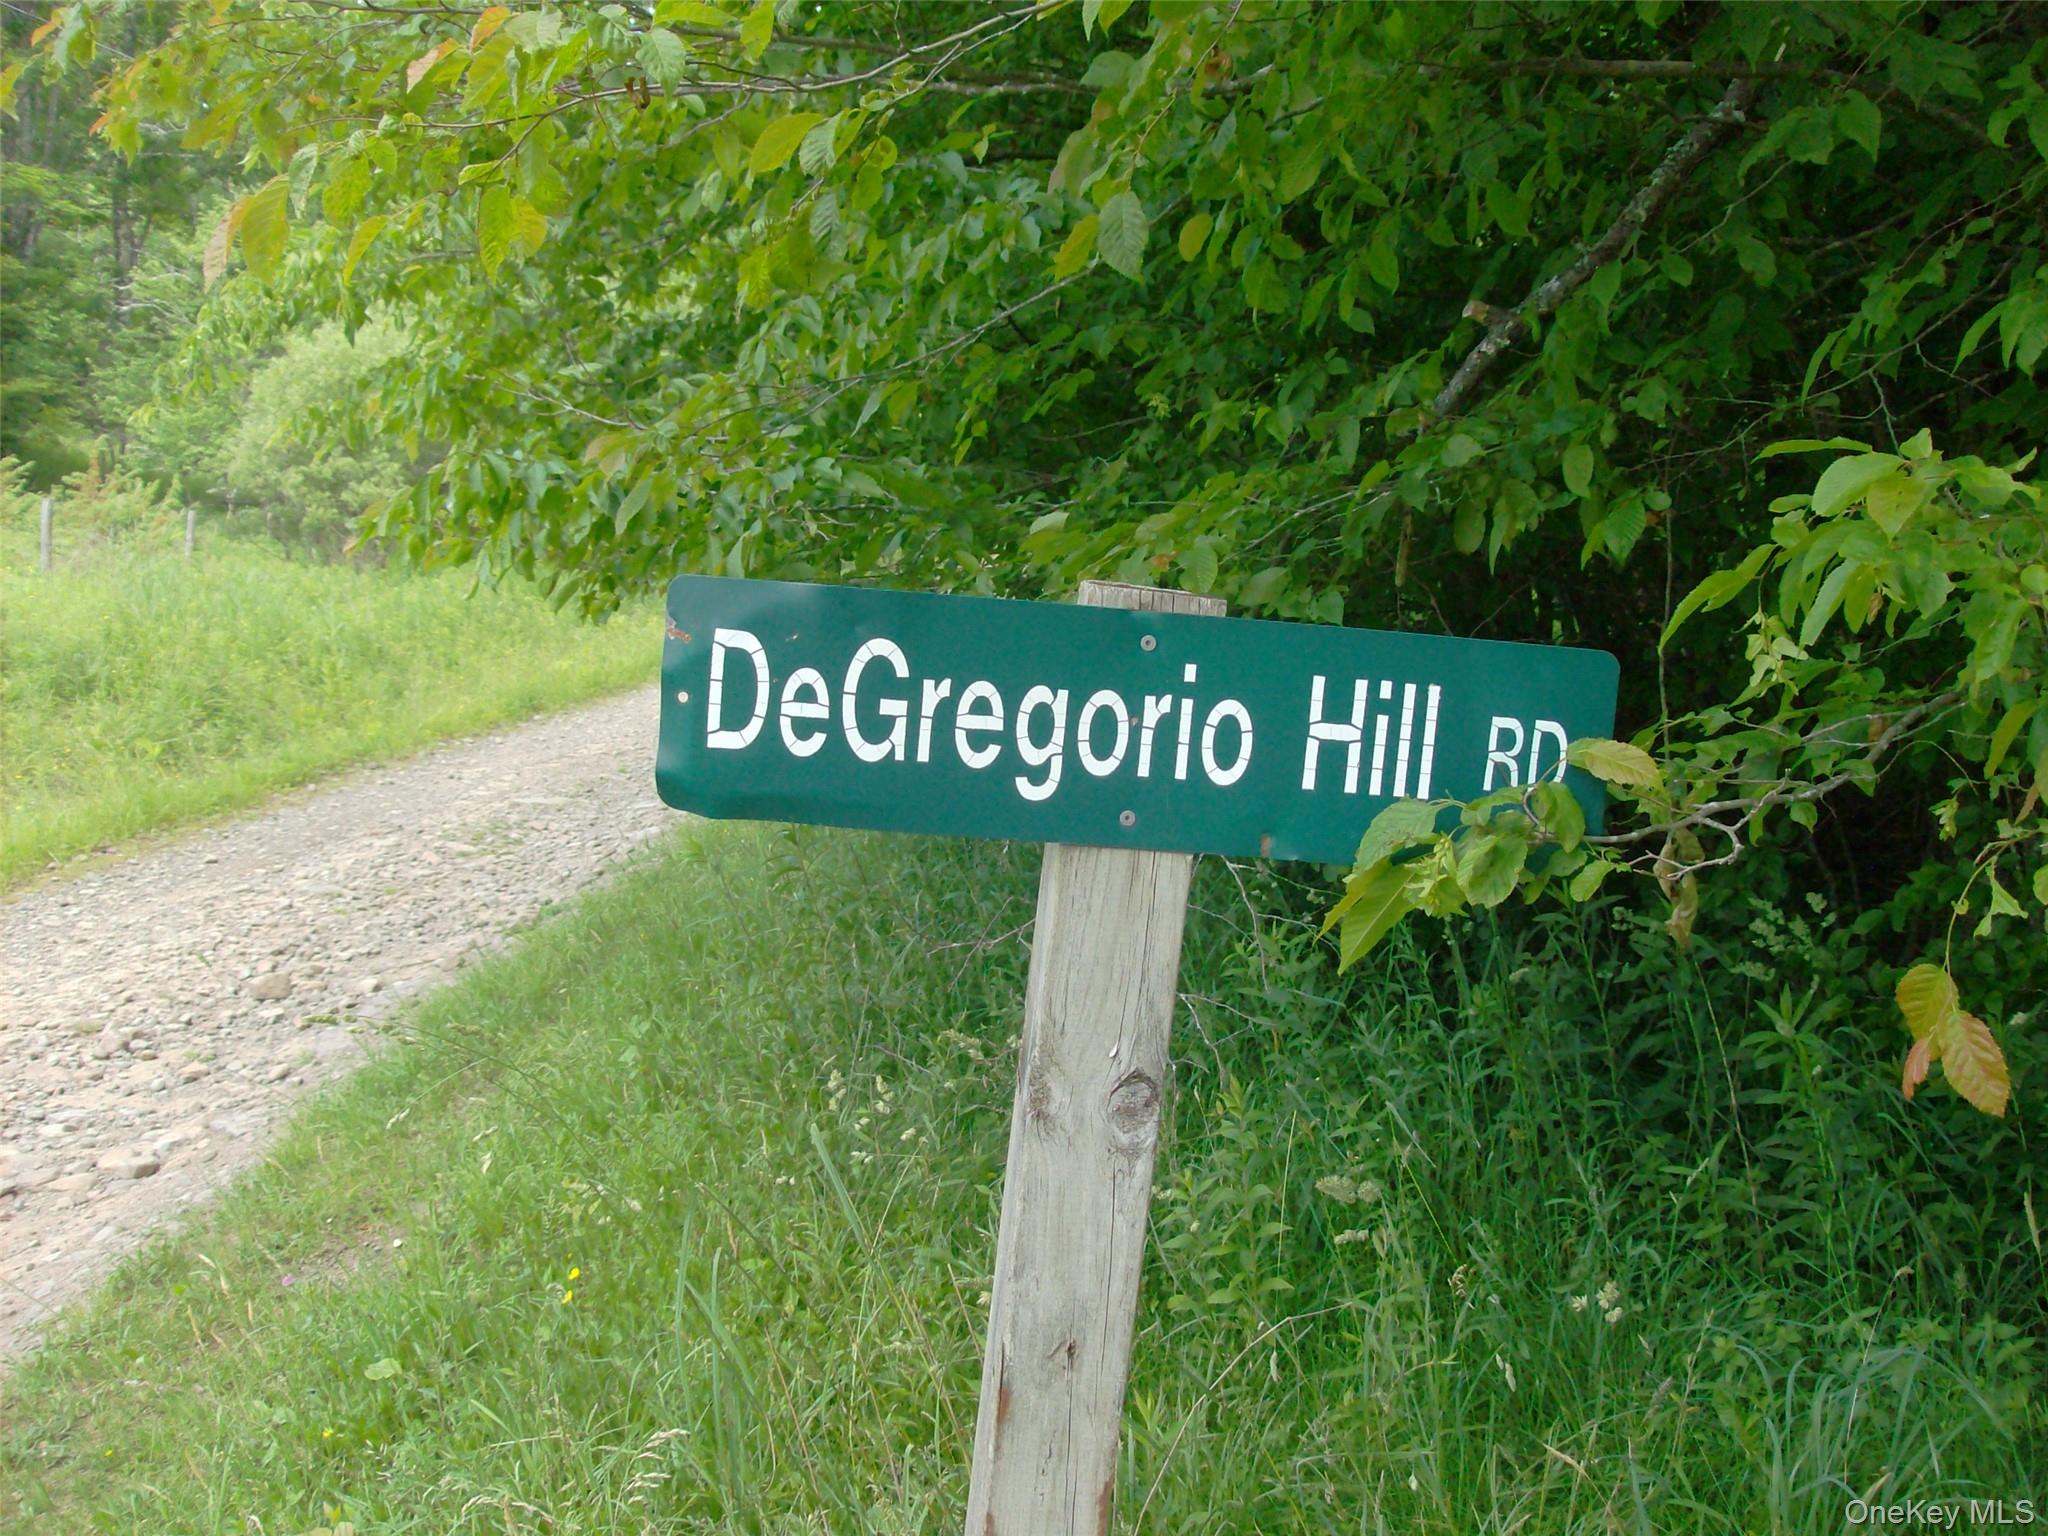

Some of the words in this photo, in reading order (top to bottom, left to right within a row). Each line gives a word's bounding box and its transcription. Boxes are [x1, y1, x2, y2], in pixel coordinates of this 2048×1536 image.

[706, 628, 1253, 801] DeGregorio
[1302, 675, 1441, 799] Hill
[1484, 716, 1569, 793] RD
